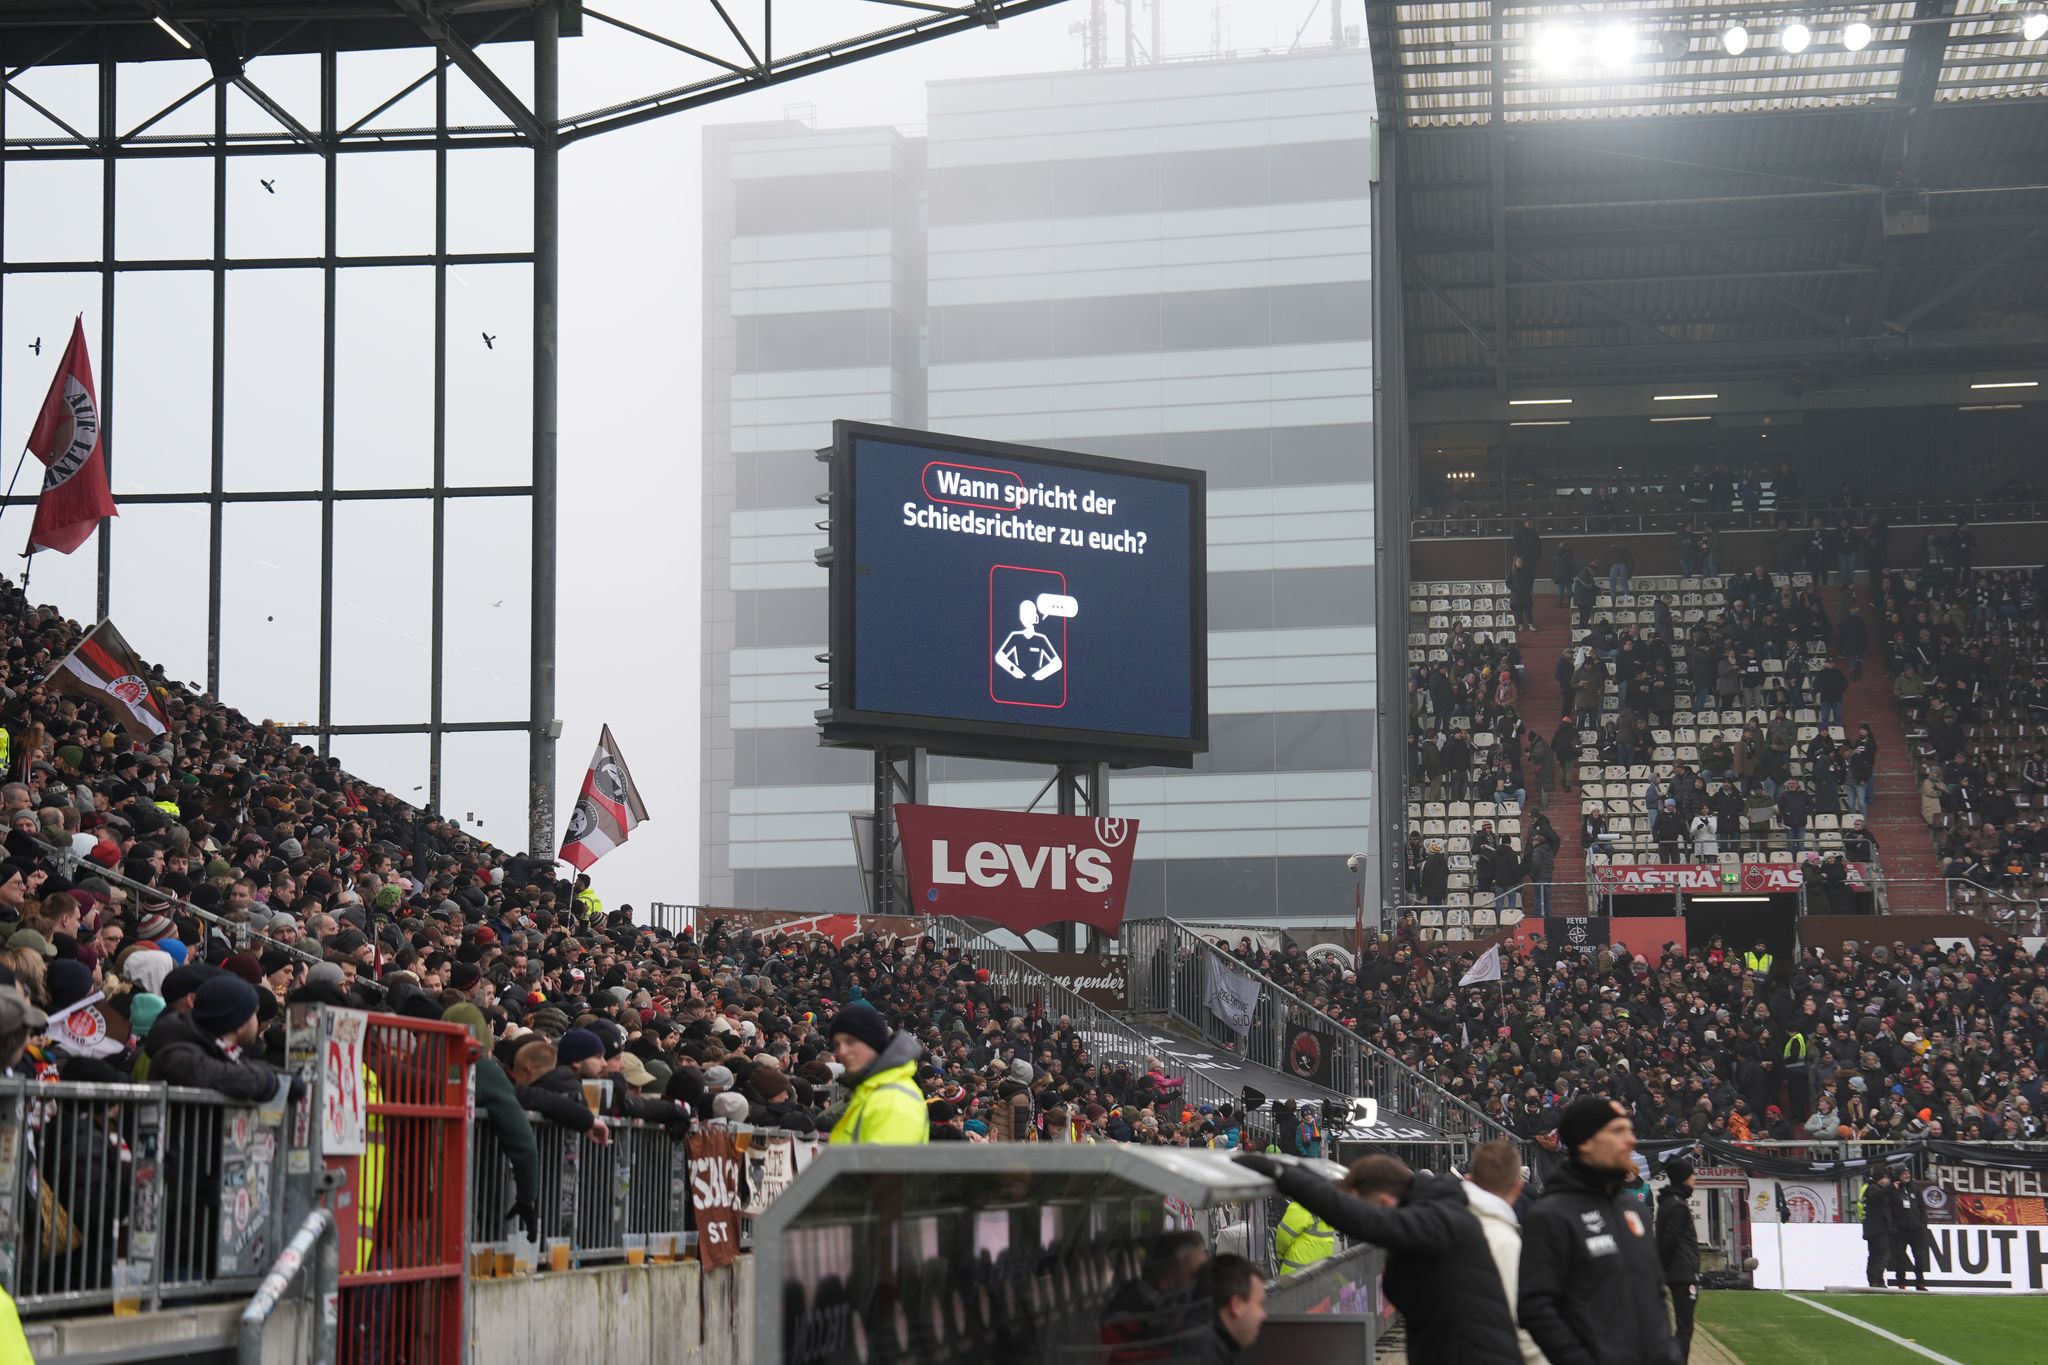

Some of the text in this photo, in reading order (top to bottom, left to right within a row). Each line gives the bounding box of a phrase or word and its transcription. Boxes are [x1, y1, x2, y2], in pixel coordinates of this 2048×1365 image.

[937, 470, 1116, 516] Wann spricht der
[903, 502, 1147, 555] Schiedsrichter zu euch?
[1622, 869, 1717, 889] ASTRA
[1072, 971, 1125, 994] gender
[1938, 1165, 2048, 1197] PELEMEL
[708, 1221, 729, 1244] ST
